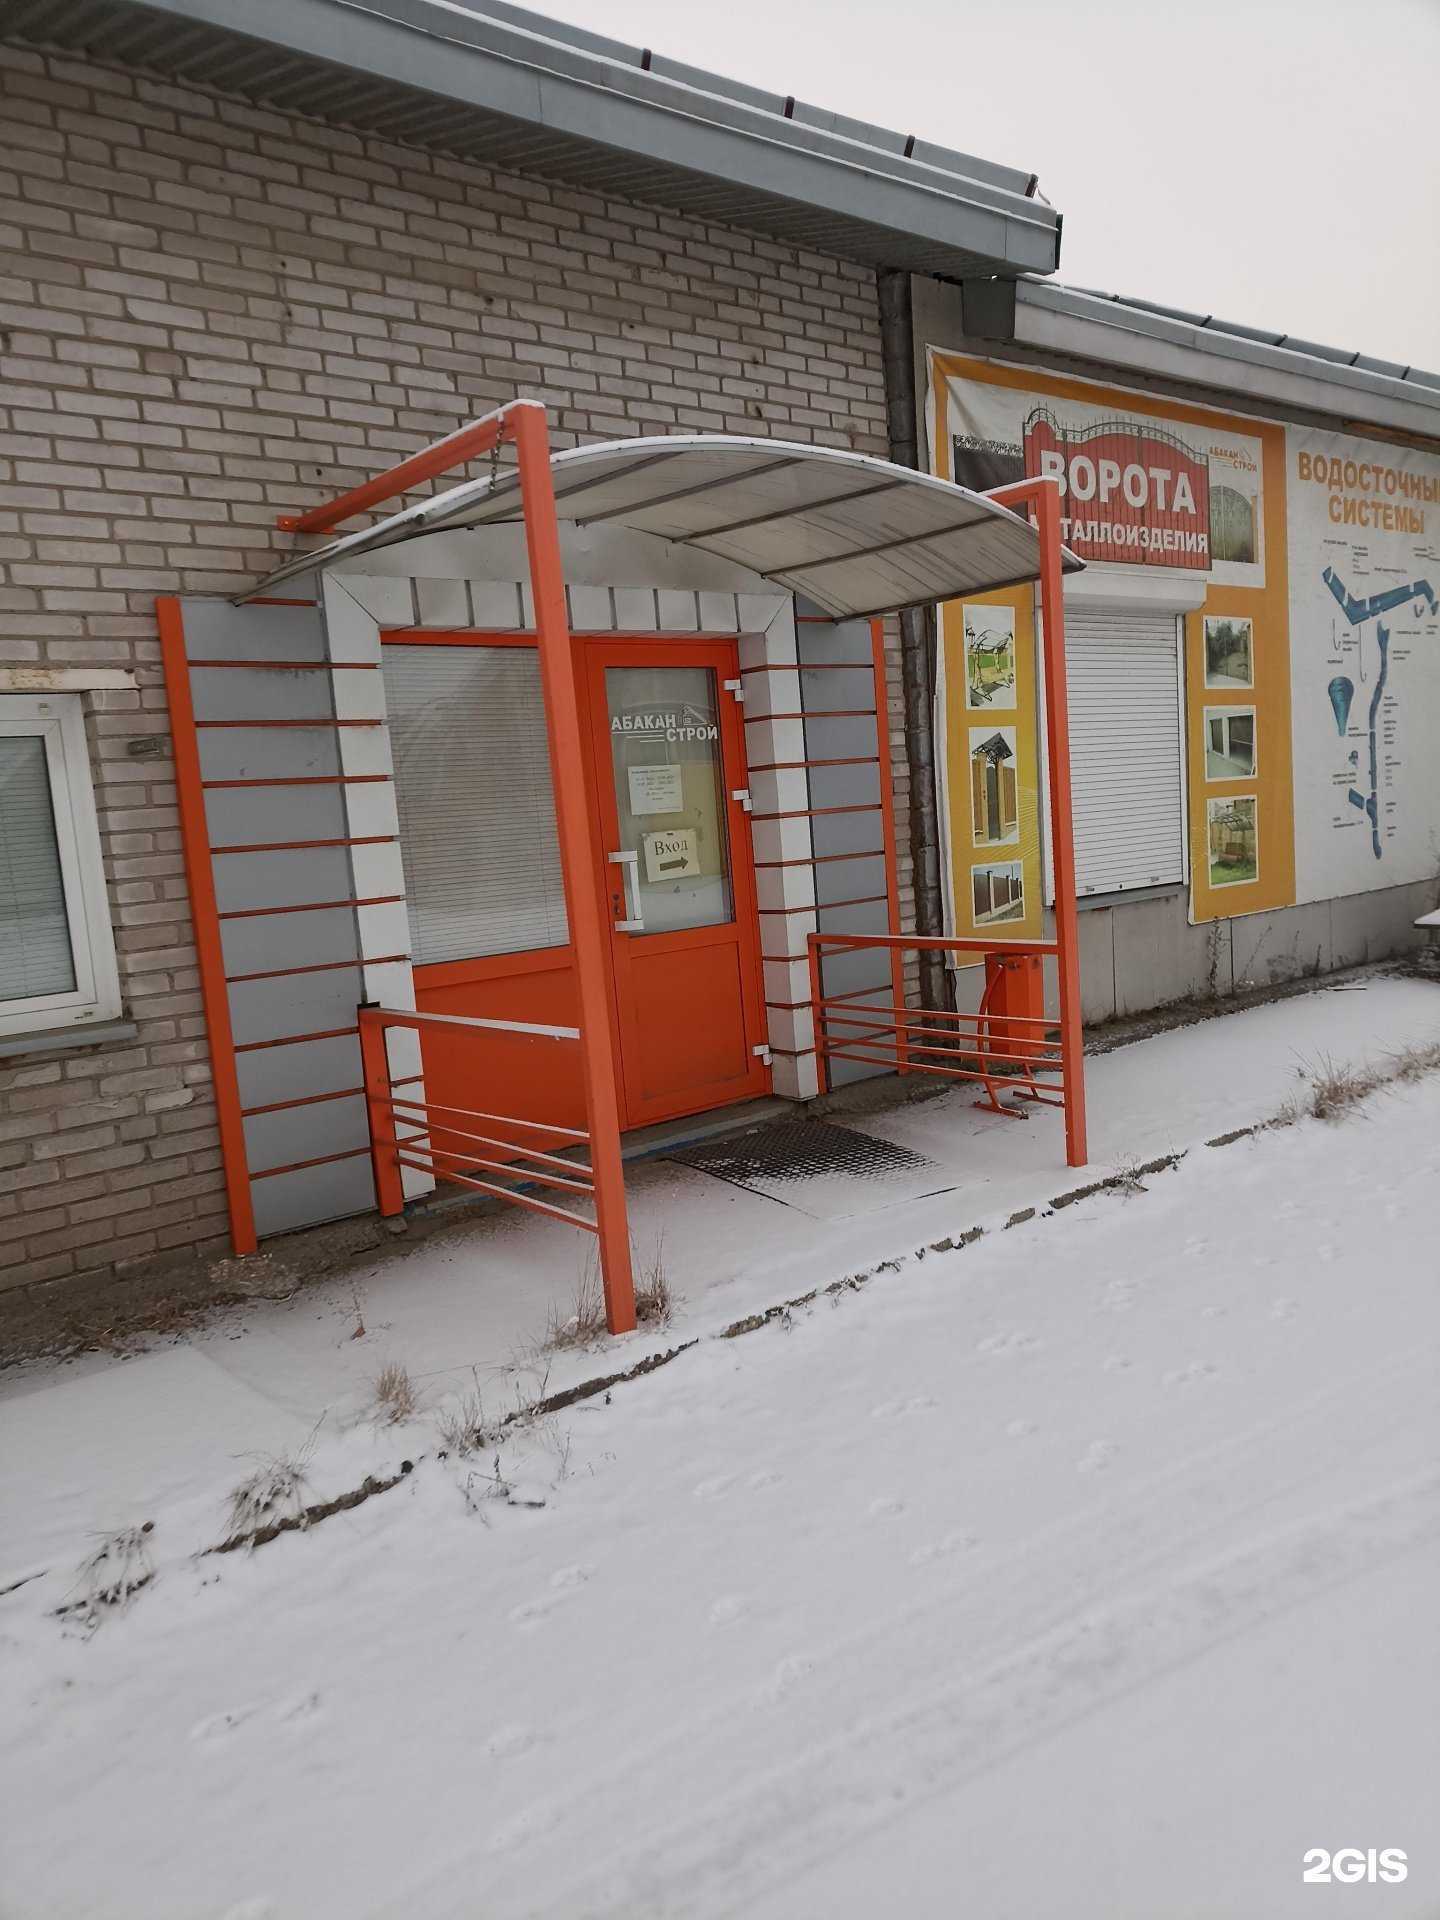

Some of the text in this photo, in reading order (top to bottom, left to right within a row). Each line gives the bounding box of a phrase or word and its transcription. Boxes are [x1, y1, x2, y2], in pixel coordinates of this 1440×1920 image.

[1041, 450, 1196, 515] ВОРОТА
[1298, 451, 1440, 503] ВОДОСТОЧНЫ
[1030, 514, 1208, 553] ТАЛЛОИЗДЕЛИЯ
[1328, 495, 1425, 535] СИСТЕМЫ
[611, 714, 677, 730] АБАКАН
[666, 724, 718, 742] СТРОЙ
[655, 840, 688, 856] Вход
